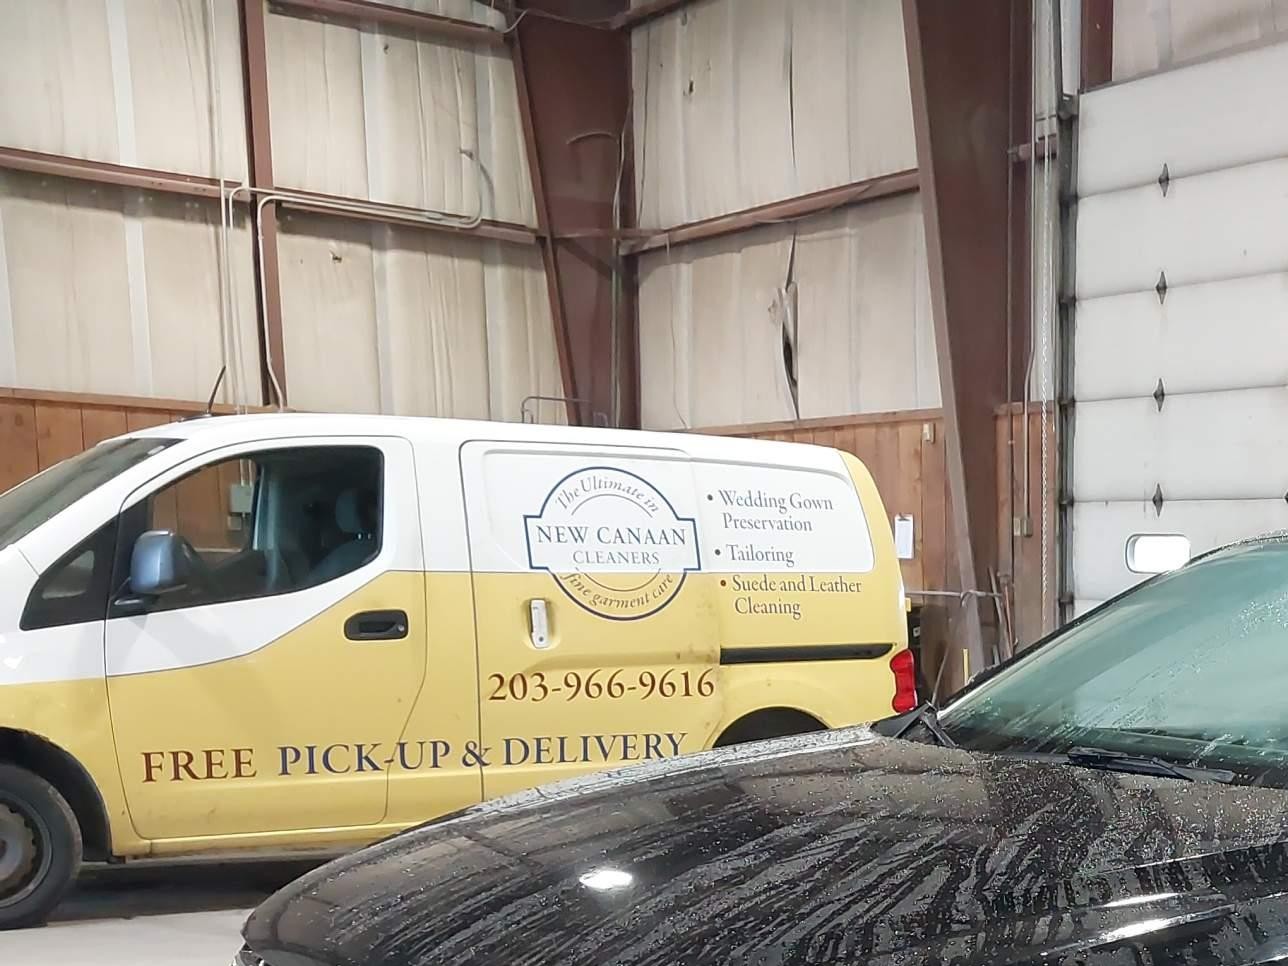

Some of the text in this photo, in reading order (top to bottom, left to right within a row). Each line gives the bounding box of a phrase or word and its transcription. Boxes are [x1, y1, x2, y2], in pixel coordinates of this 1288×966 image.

[555, 475, 660, 513] The Ultimate in
[718, 489, 833, 511] Wedding Gown
[723, 512, 812, 532] Preservation
[537, 525, 687, 546] NEW CANAAN
[572, 550, 660, 565] CLEANERS
[728, 545, 795, 567] Tailoring
[732, 576, 862, 593] Suede and Leather
[588, 594, 652, 609] garment
[734, 598, 802, 620] Cleaning
[488, 668, 715, 703] 203-966-9616
[142, 732, 689, 782] FREE PICK-UP & DELIVERY
